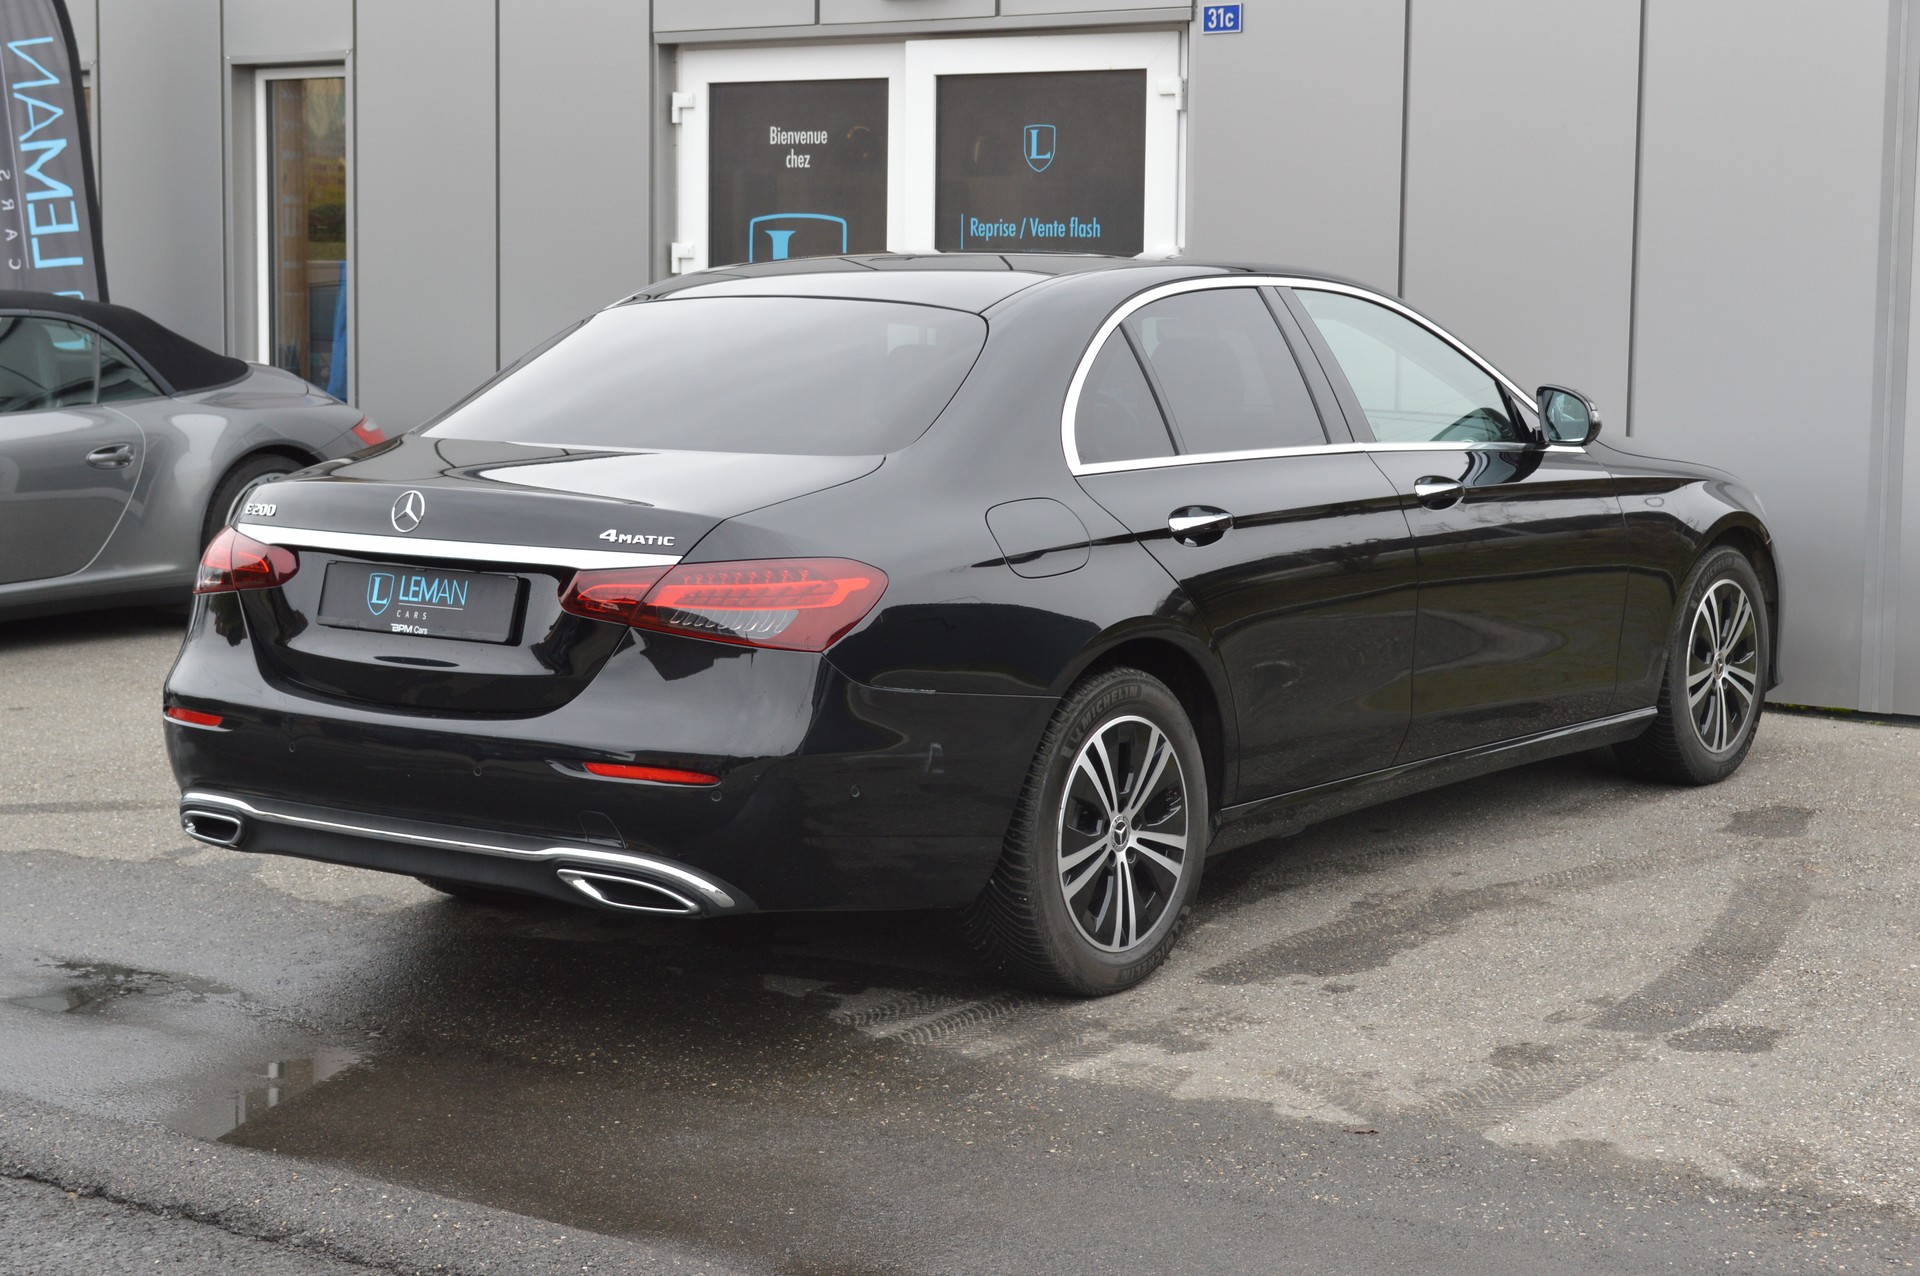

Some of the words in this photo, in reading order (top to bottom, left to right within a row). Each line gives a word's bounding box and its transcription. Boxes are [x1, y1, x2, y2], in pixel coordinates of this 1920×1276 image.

[1208, 8, 1234, 29] 31c
[769, 126, 828, 145] Bienvenue
[1029, 129, 1051, 160] L
[786, 149, 811, 168] chez
[970, 217, 1017, 241] Reprise
[1019, 217, 1027, 239] /
[1030, 217, 1066, 238] Vente
[1069, 216, 1101, 238] flash
[244, 503, 277, 516] E200
[599, 528, 676, 546] 4MATIC
[370, 576, 388, 605] L
[398, 575, 469, 606] LEMAN
[396, 609, 427, 620] CARS
[391, 623, 413, 634] BPM
[413, 625, 428, 635] Cars
[1081, 685, 1139, 729] MICHELIN
